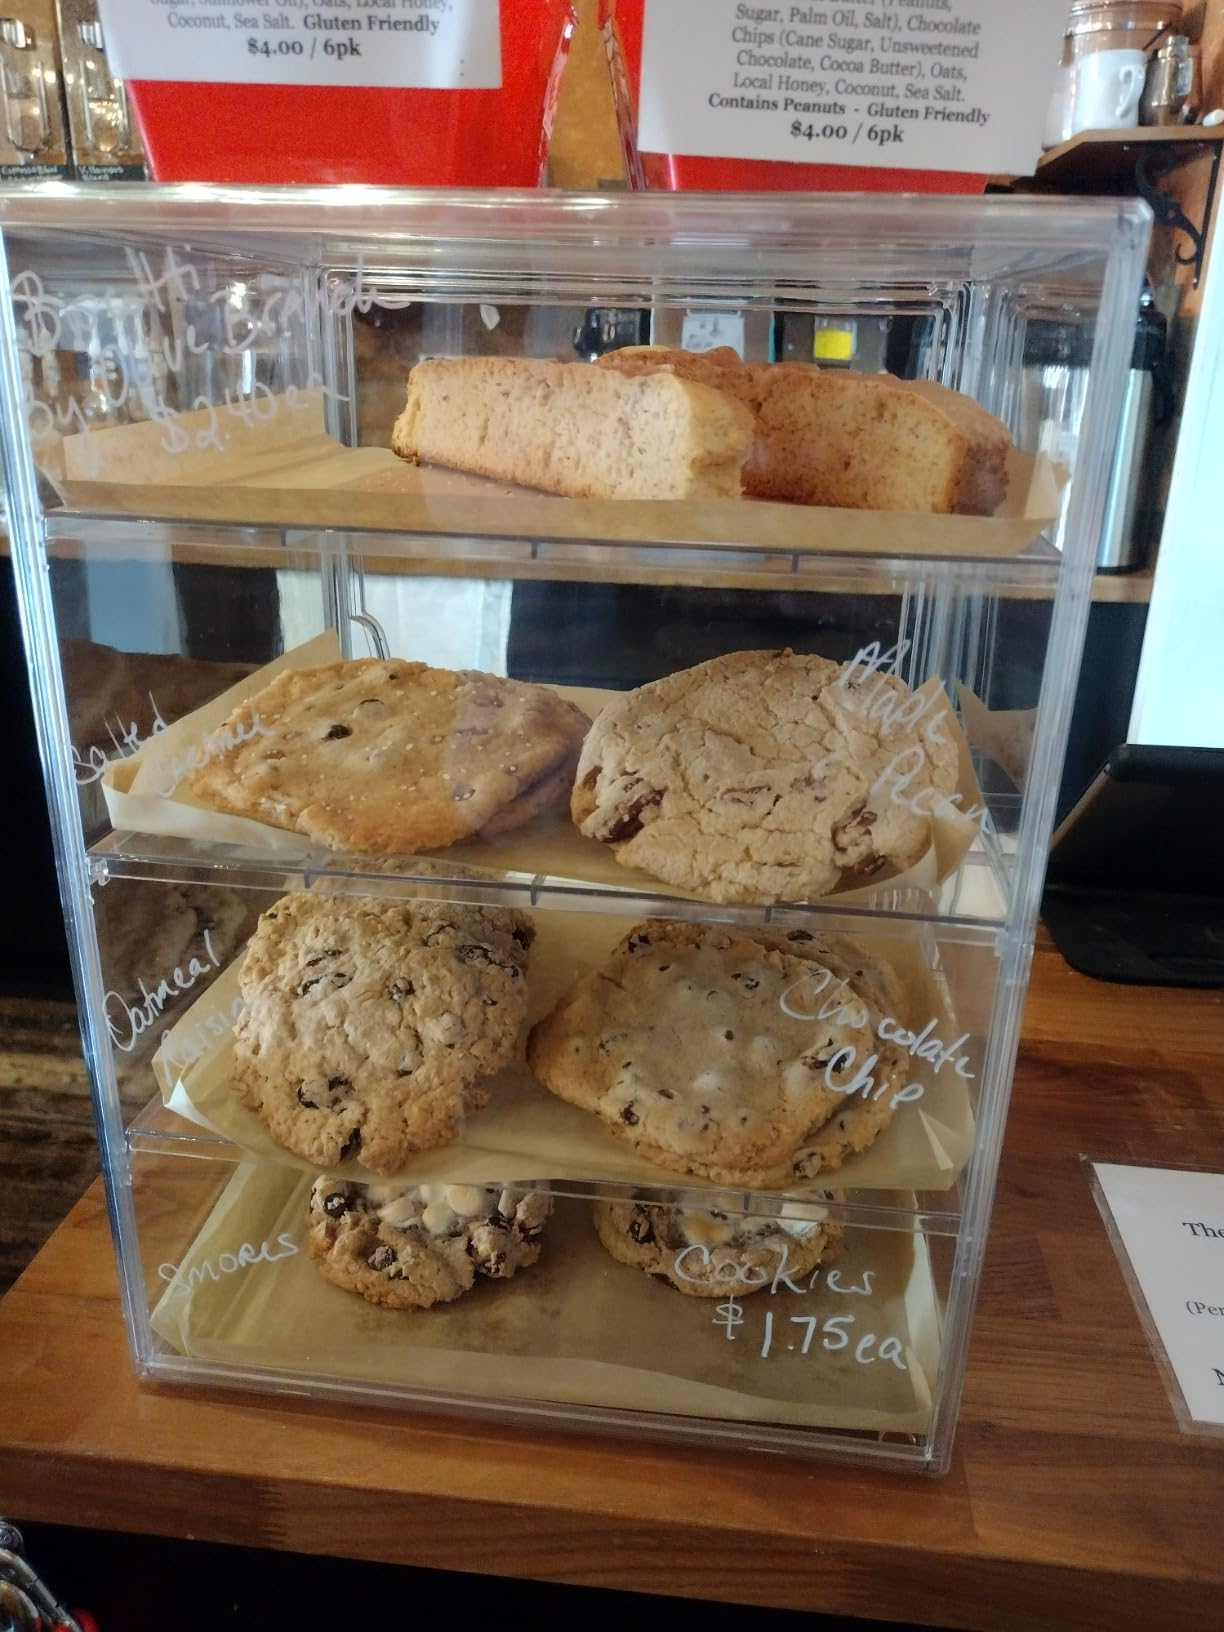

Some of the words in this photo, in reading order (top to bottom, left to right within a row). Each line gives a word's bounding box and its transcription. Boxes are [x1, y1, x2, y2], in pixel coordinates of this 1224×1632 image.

[167, 11, 231, 30] Coconut,
[233, 13, 259, 29] Sea
[262, 13, 296, 30] Salt.
[303, 13, 362, 31] Gluten
[366, 14, 440, 36] Friendly
[736, 3, 784, 25] Sugar,
[789, 7, 827, 26] Palm
[832, 9, 859, 29] Oil,
[907, 15, 981, 36] Chocolate
[248, 37, 303, 58] $4.00
[309, 38, 318, 60] /
[323, 37, 362, 59] 6pk
[732, 26, 775, 48] Chips
[779, 29, 824, 49] (Cane
[827, 32, 875, 55] Sugar,
[880, 35, 979, 59] Unsweetened
[737, 49, 815, 72] Chocolate,
[819, 54, 864, 74] Cocoa
[869, 58, 925, 79] Butter),
[931, 62, 967, 81] Oats,
[733, 71, 773, 90] Local
[778, 75, 830, 97] Honey,
[835, 79, 900, 99] Coconut,
[904, 83, 929, 100] Sea
[933, 85, 965, 102] Salt.
[708, 92, 779, 111] Contains
[783, 97, 846, 115] Peanuts
[867, 102, 919, 120] Gluten
[924, 106, 990, 127] Friendly
[790, 120, 848, 141] $4.00
[852, 122, 863, 145] /
[867, 124, 904, 146] 6pk
[101, 928, 221, 1052] Oatmeal
[779, 968, 976, 1079] Chocolate
[824, 1046, 926, 1110] Chip
[674, 1244, 876, 1296] Cookies
